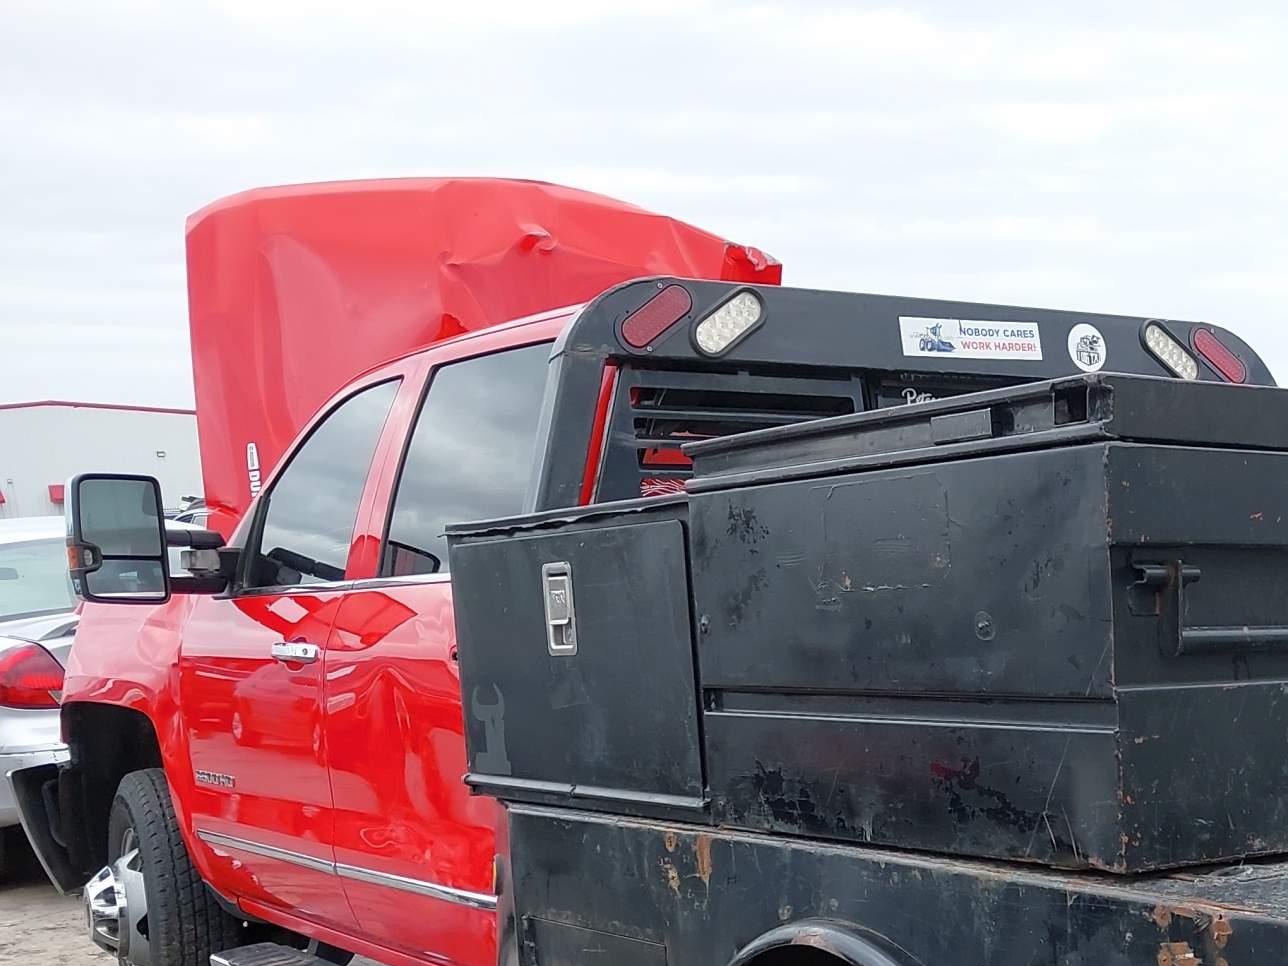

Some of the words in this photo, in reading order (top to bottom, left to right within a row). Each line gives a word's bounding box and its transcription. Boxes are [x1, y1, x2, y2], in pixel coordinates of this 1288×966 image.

[960, 327, 1000, 338] NOBODY
[1003, 329, 1035, 338] CARES
[961, 341, 992, 351] WORK
[994, 342, 1037, 352] HARDER!
